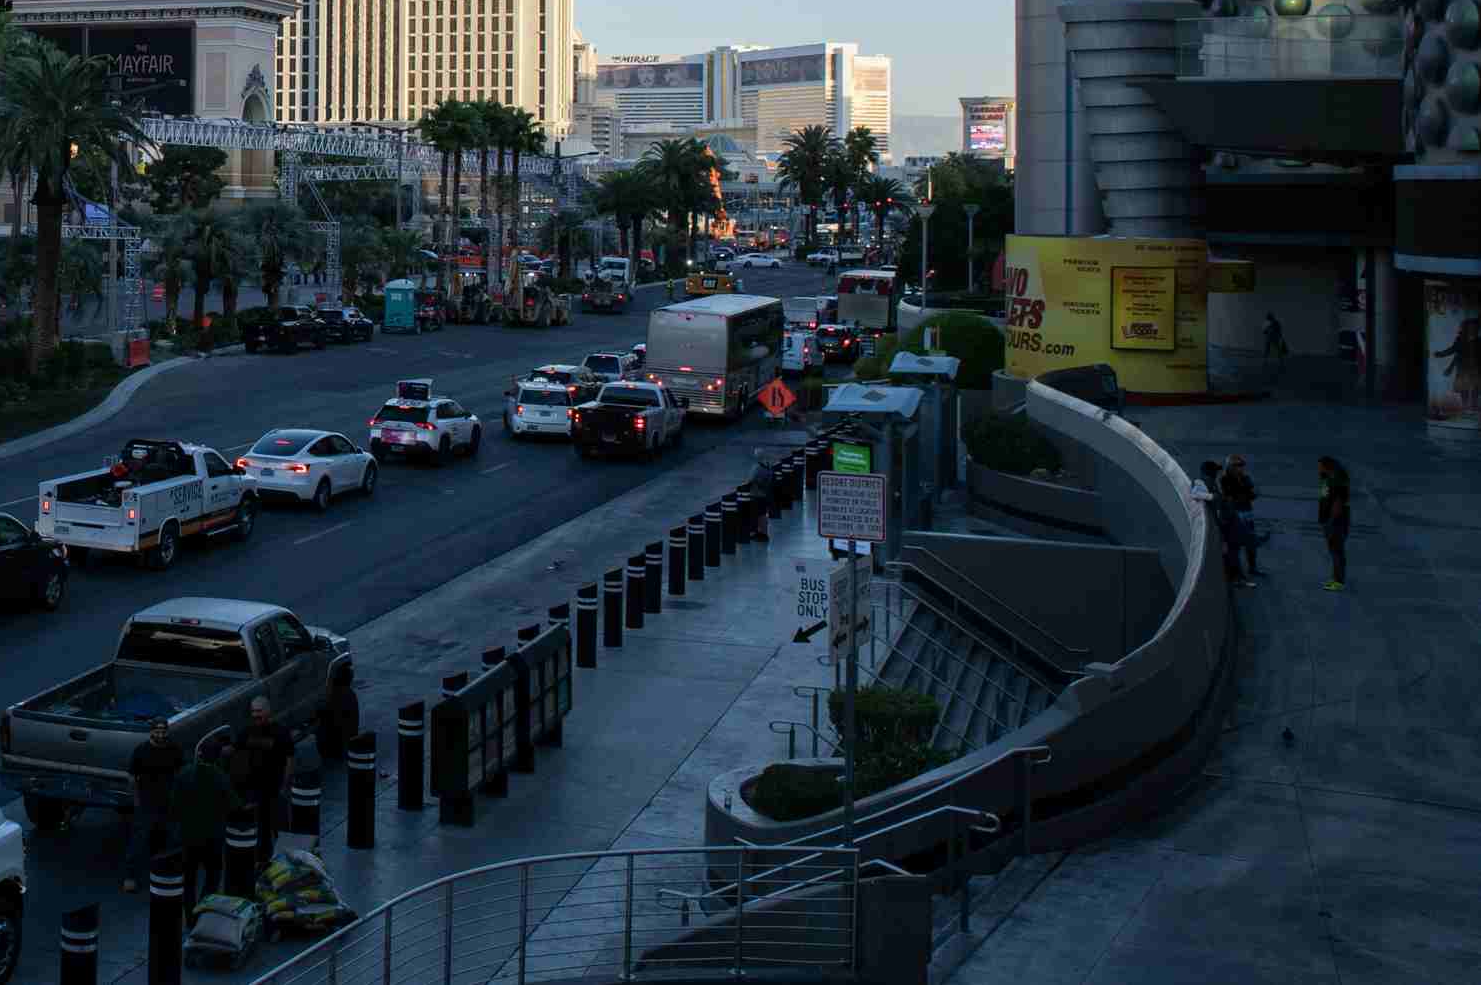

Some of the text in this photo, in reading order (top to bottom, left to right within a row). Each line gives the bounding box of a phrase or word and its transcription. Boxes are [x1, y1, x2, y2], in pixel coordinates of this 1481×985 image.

[108, 54, 175, 75] MAYFAIR
[620, 54, 660, 63] MIRAGE
[801, 578, 825, 592] BUS
[798, 591, 828, 605] STOP
[798, 604, 828, 619] ONLY
